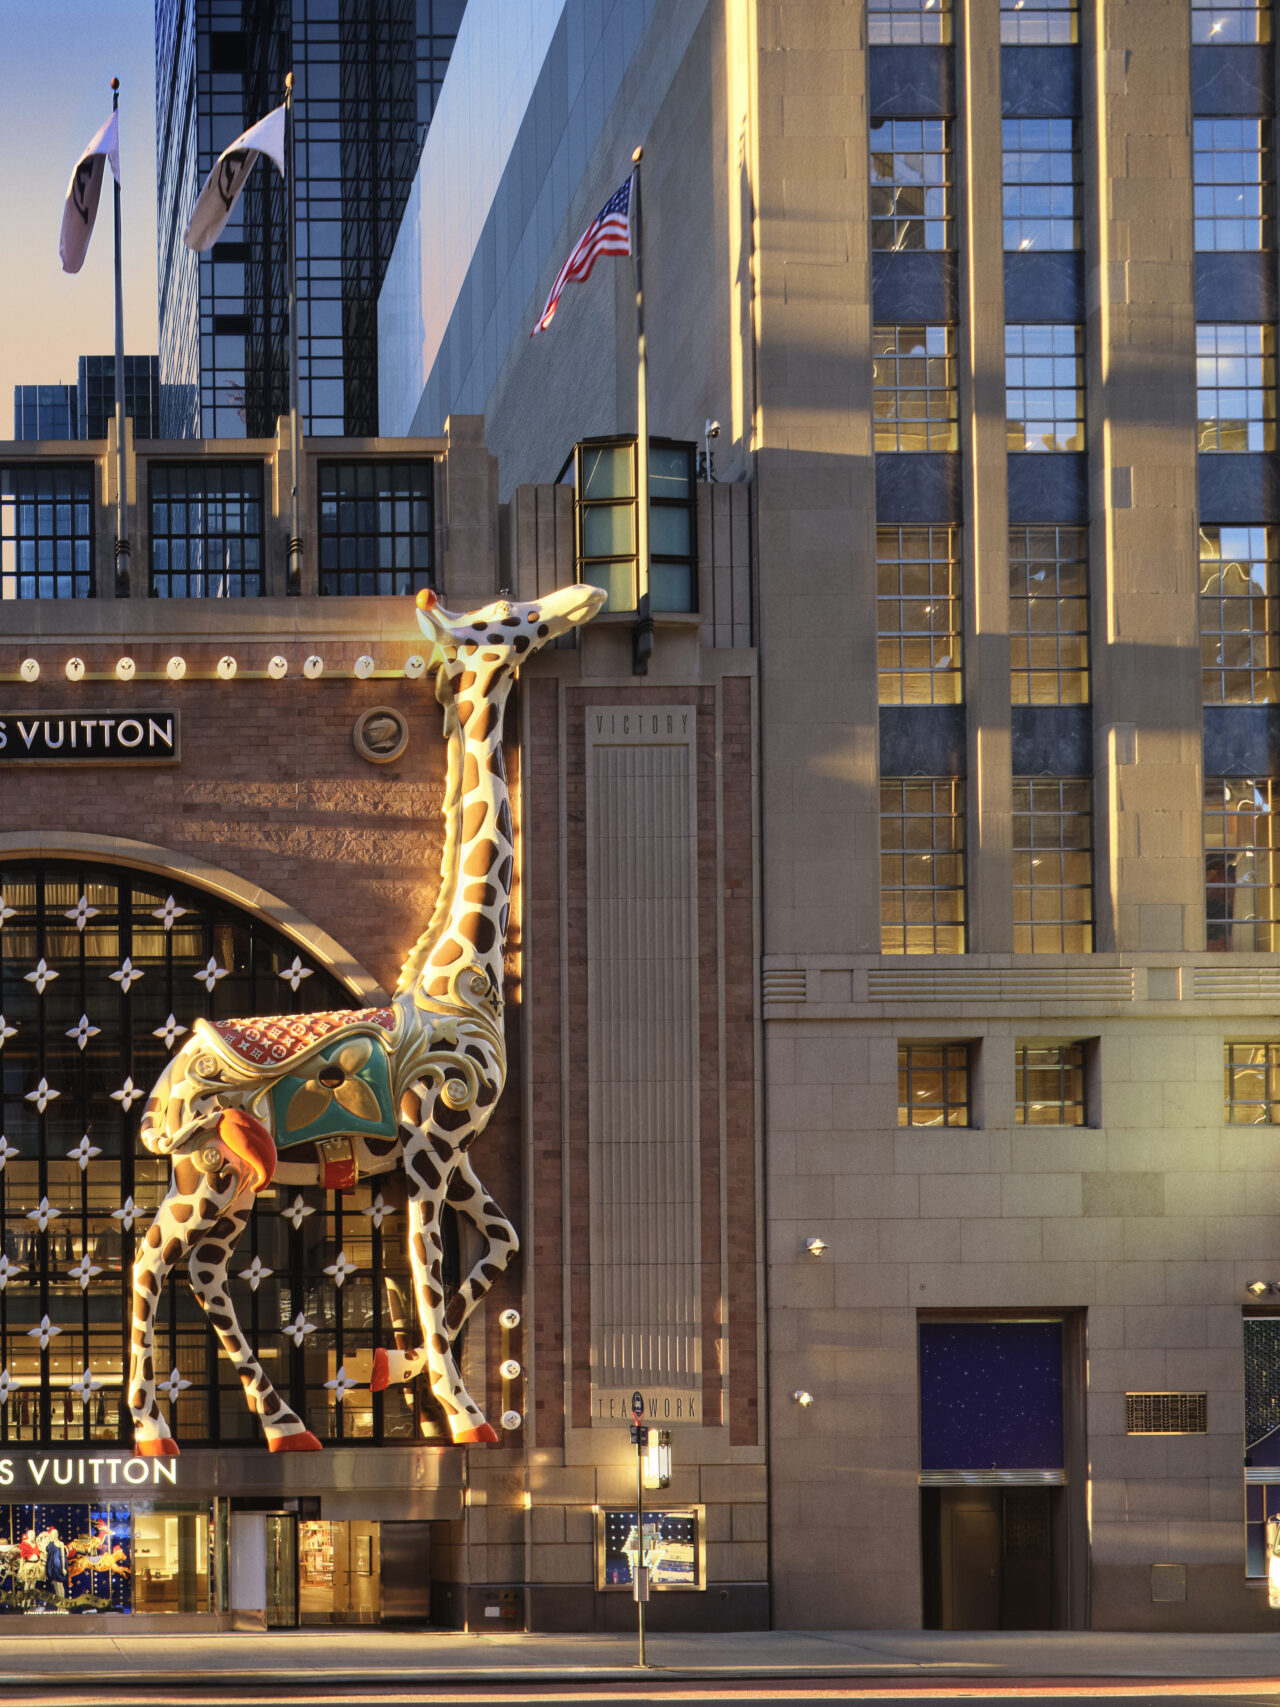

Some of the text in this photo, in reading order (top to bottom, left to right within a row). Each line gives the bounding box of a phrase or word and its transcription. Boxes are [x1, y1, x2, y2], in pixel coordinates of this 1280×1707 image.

[17, 718, 173, 750] VUITTON
[596, 715, 687, 734] VICTORY
[598, 1398, 695, 1418] TEAWORK
[27, 1458, 178, 1486] VUITTON
